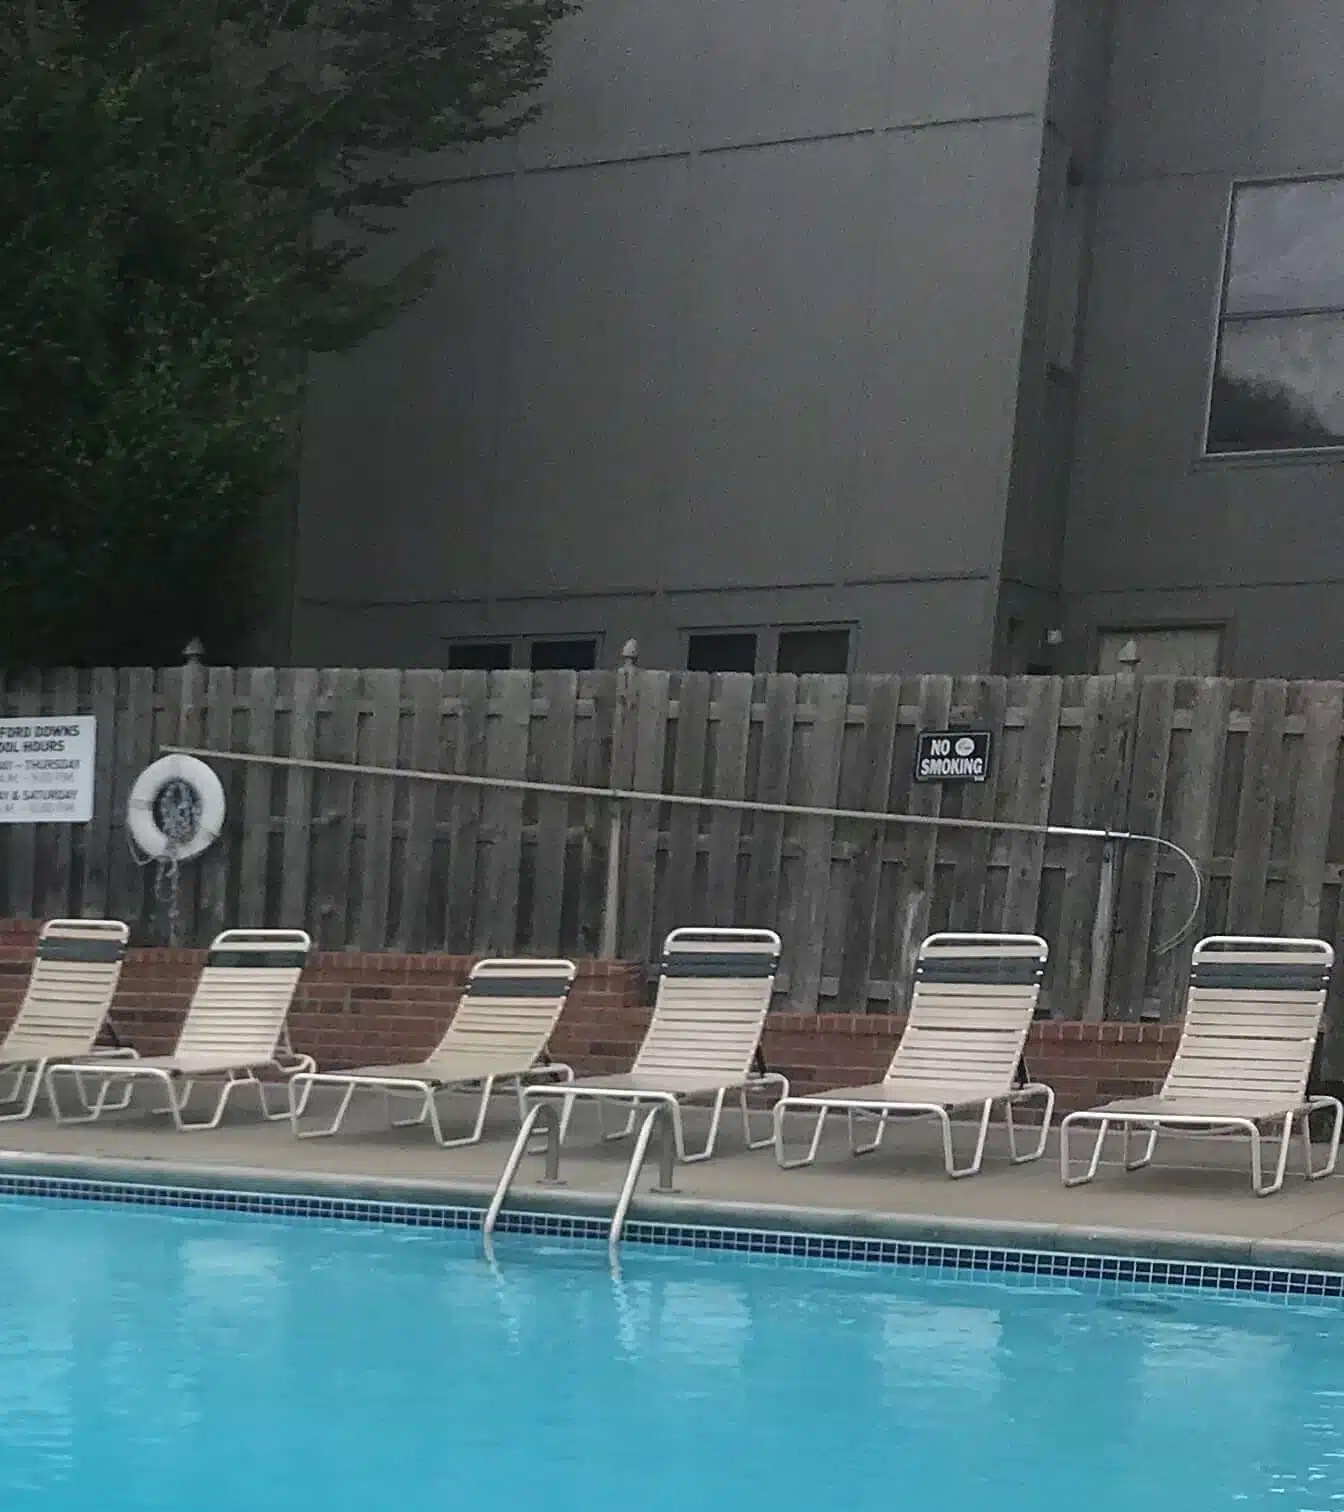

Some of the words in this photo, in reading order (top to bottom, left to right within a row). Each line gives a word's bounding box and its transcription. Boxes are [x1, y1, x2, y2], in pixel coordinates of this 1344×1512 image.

[34, 725, 81, 738] DOWNS
[23, 740, 65, 753] HOURS
[931, 739, 951, 756] NO
[920, 757, 983, 776] SMOKING
